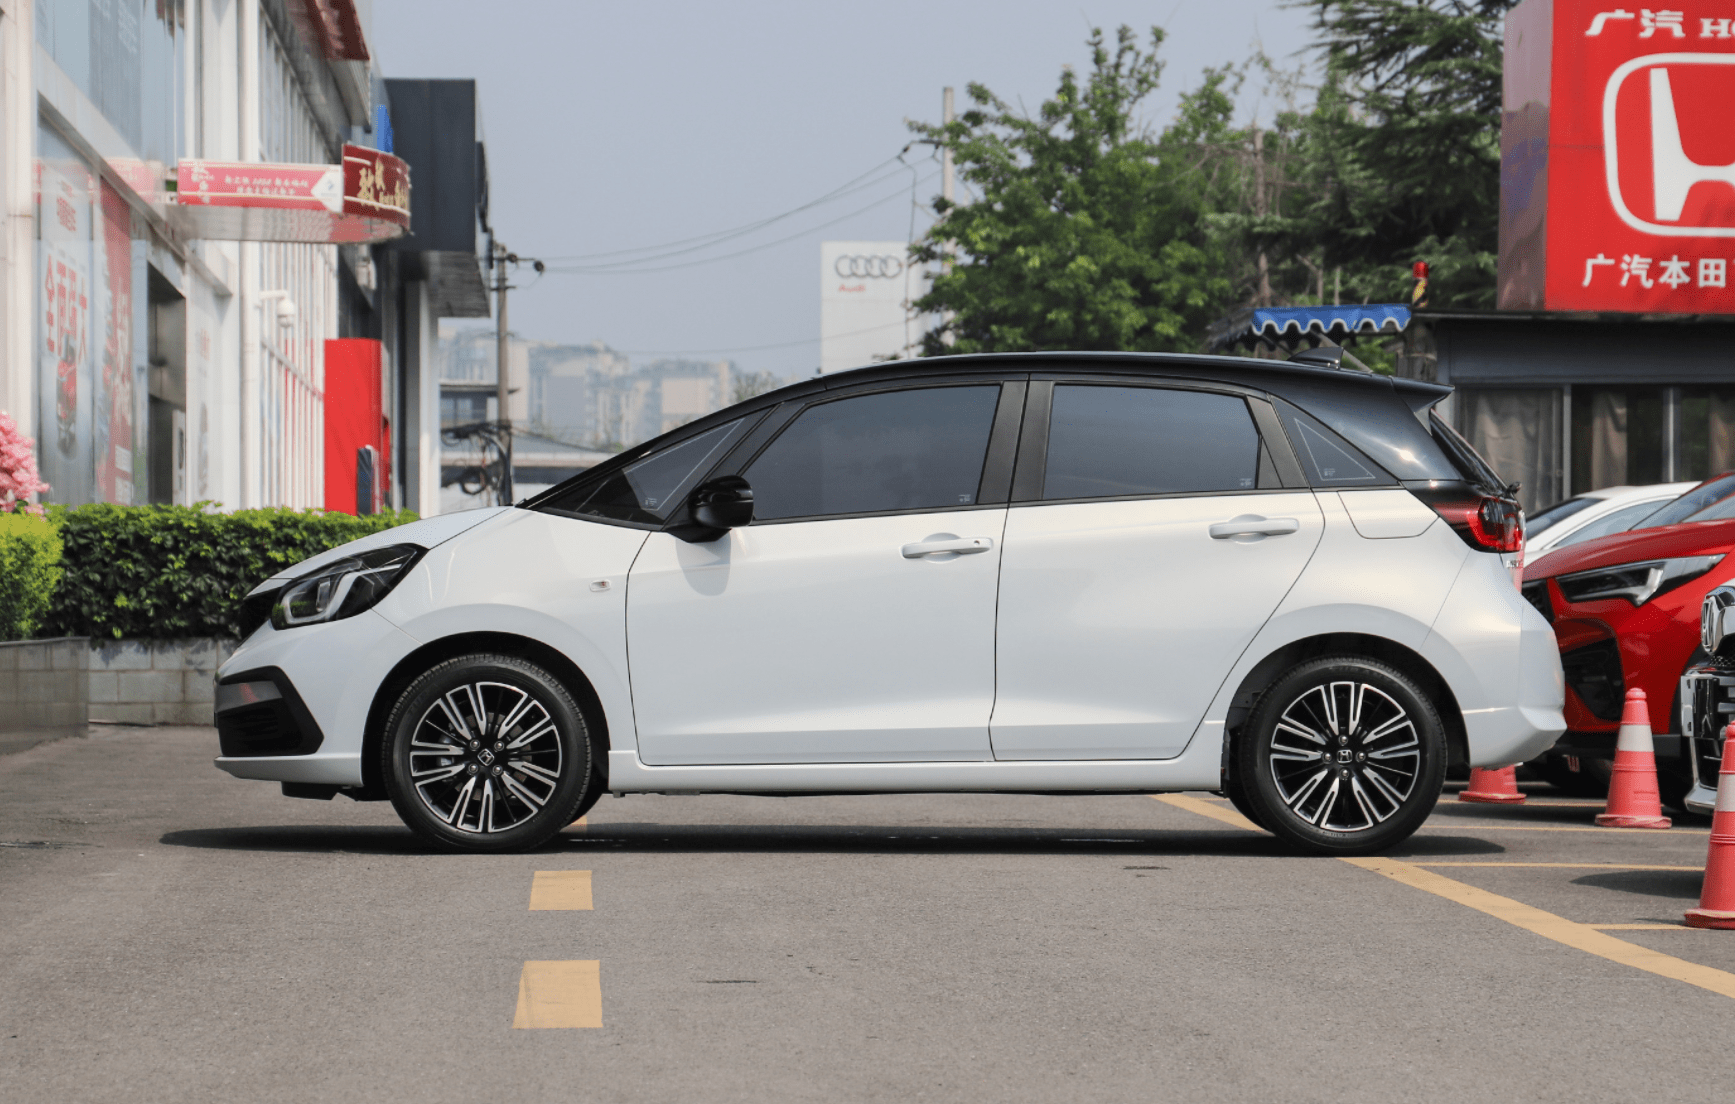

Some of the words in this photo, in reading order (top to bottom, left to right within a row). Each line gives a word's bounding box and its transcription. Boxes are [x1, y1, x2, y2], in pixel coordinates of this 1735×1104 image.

[1584, 9, 1686, 38] 广汽
[1699, 18, 1735, 39] H
[1582, 253, 1727, 289] 广汽本田
[838, 284, 866, 293] Audi
